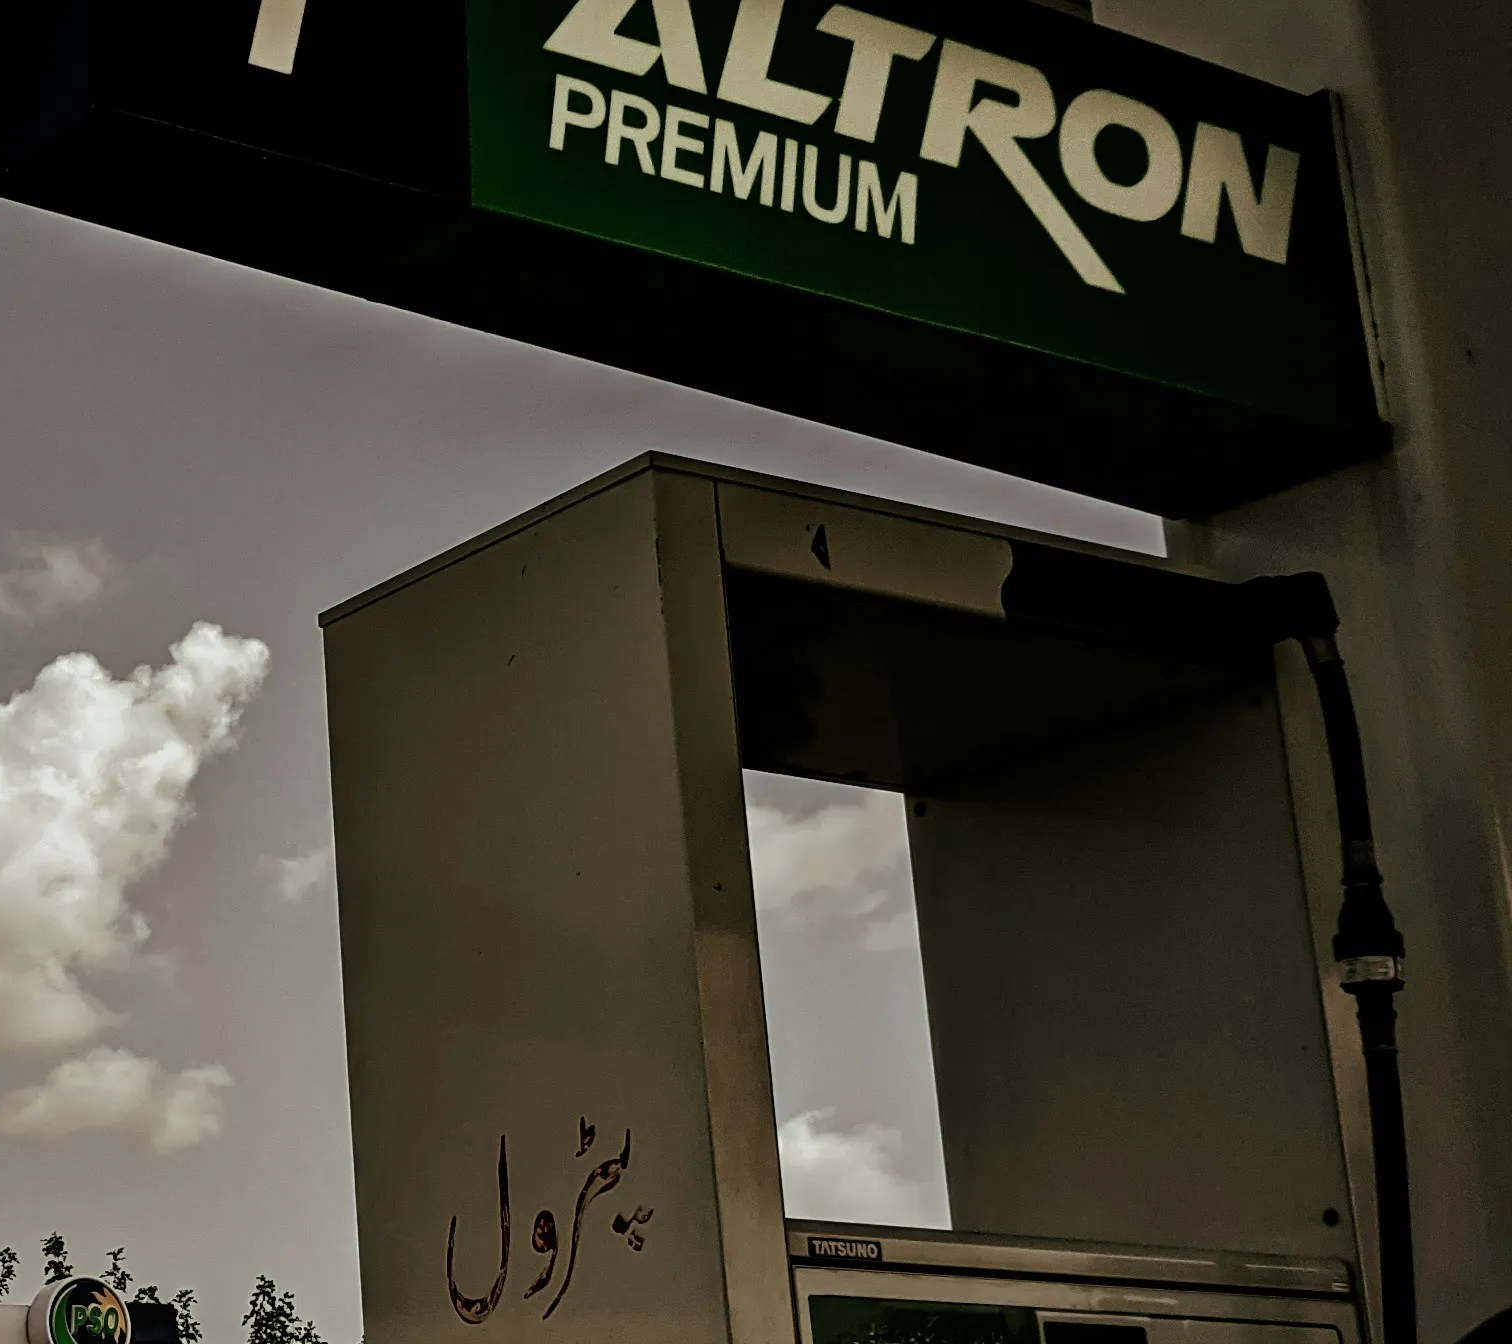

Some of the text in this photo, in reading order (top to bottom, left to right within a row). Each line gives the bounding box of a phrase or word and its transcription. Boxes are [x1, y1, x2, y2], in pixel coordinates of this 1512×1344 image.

[548, 73, 918, 245] PREMIUM
[812, 1239, 880, 1260] TATSUNO
[70, 1304, 120, 1338] PSO
